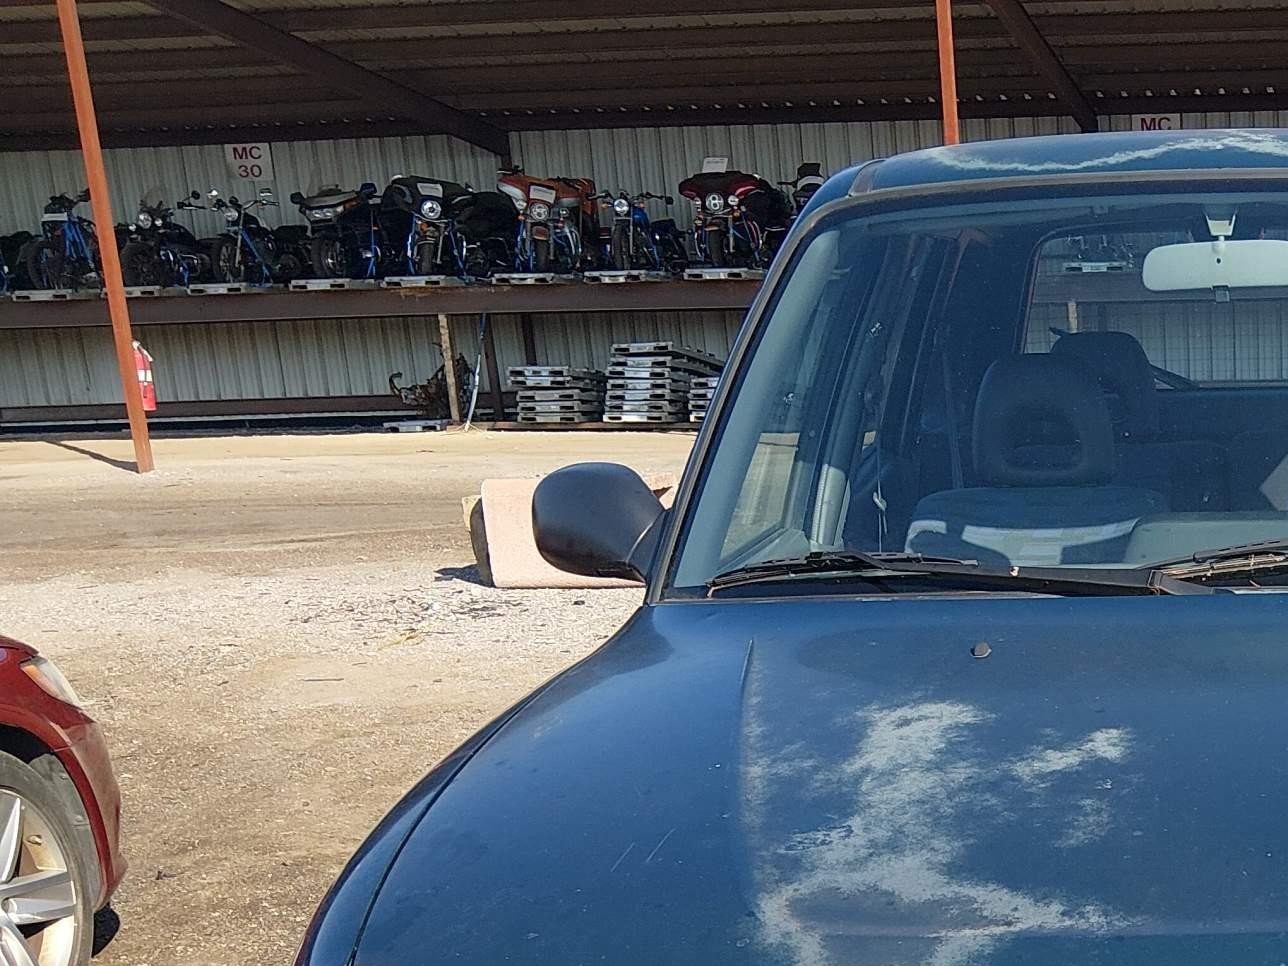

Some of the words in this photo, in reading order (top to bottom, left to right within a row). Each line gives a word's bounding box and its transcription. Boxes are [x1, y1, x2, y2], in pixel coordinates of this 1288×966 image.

[1140, 117, 1171, 131] MC
[232, 146, 262, 160] MC
[238, 164, 262, 178] 30
